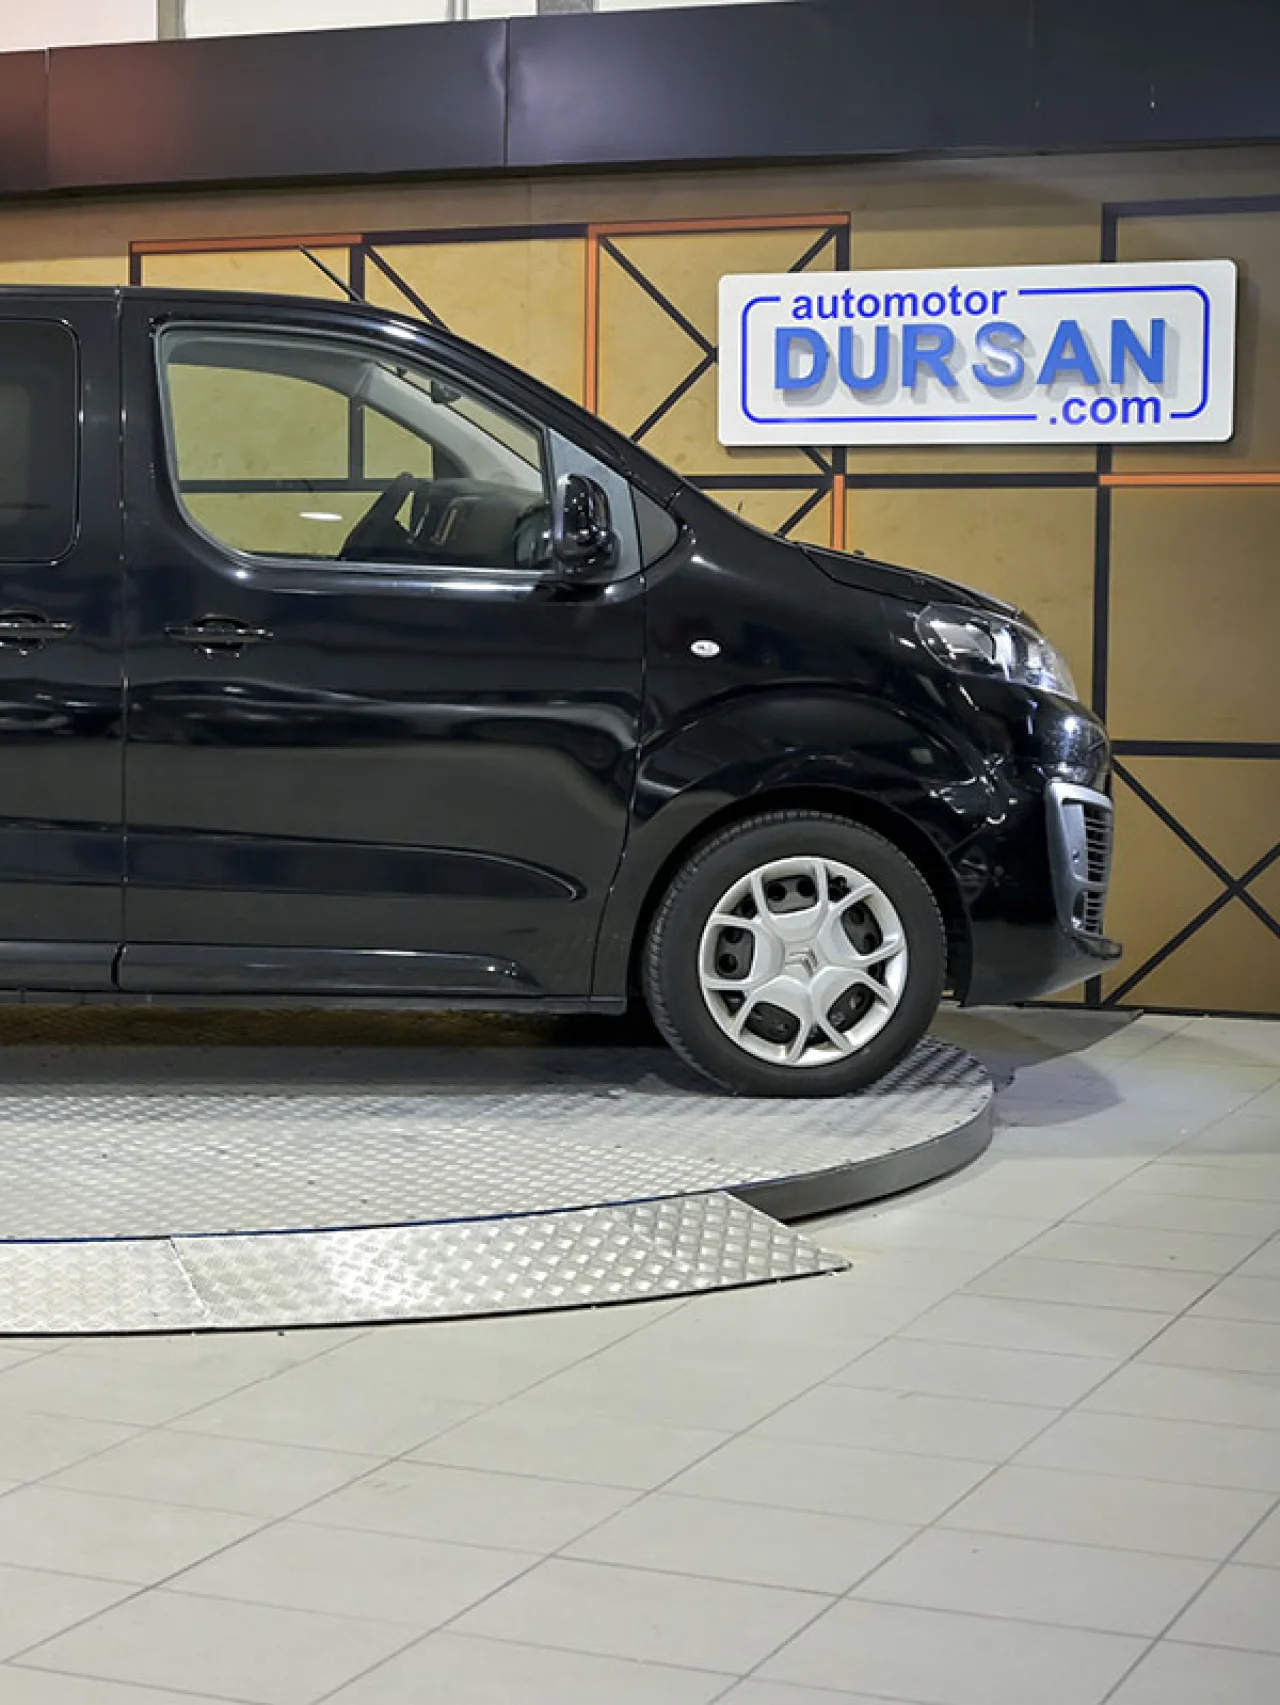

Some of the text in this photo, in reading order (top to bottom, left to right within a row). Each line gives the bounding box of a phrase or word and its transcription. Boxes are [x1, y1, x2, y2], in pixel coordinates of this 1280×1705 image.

[792, 285, 1008, 320] automotor
[774, 318, 1166, 390] DURSAN
[1048, 395, 1162, 425] .com
